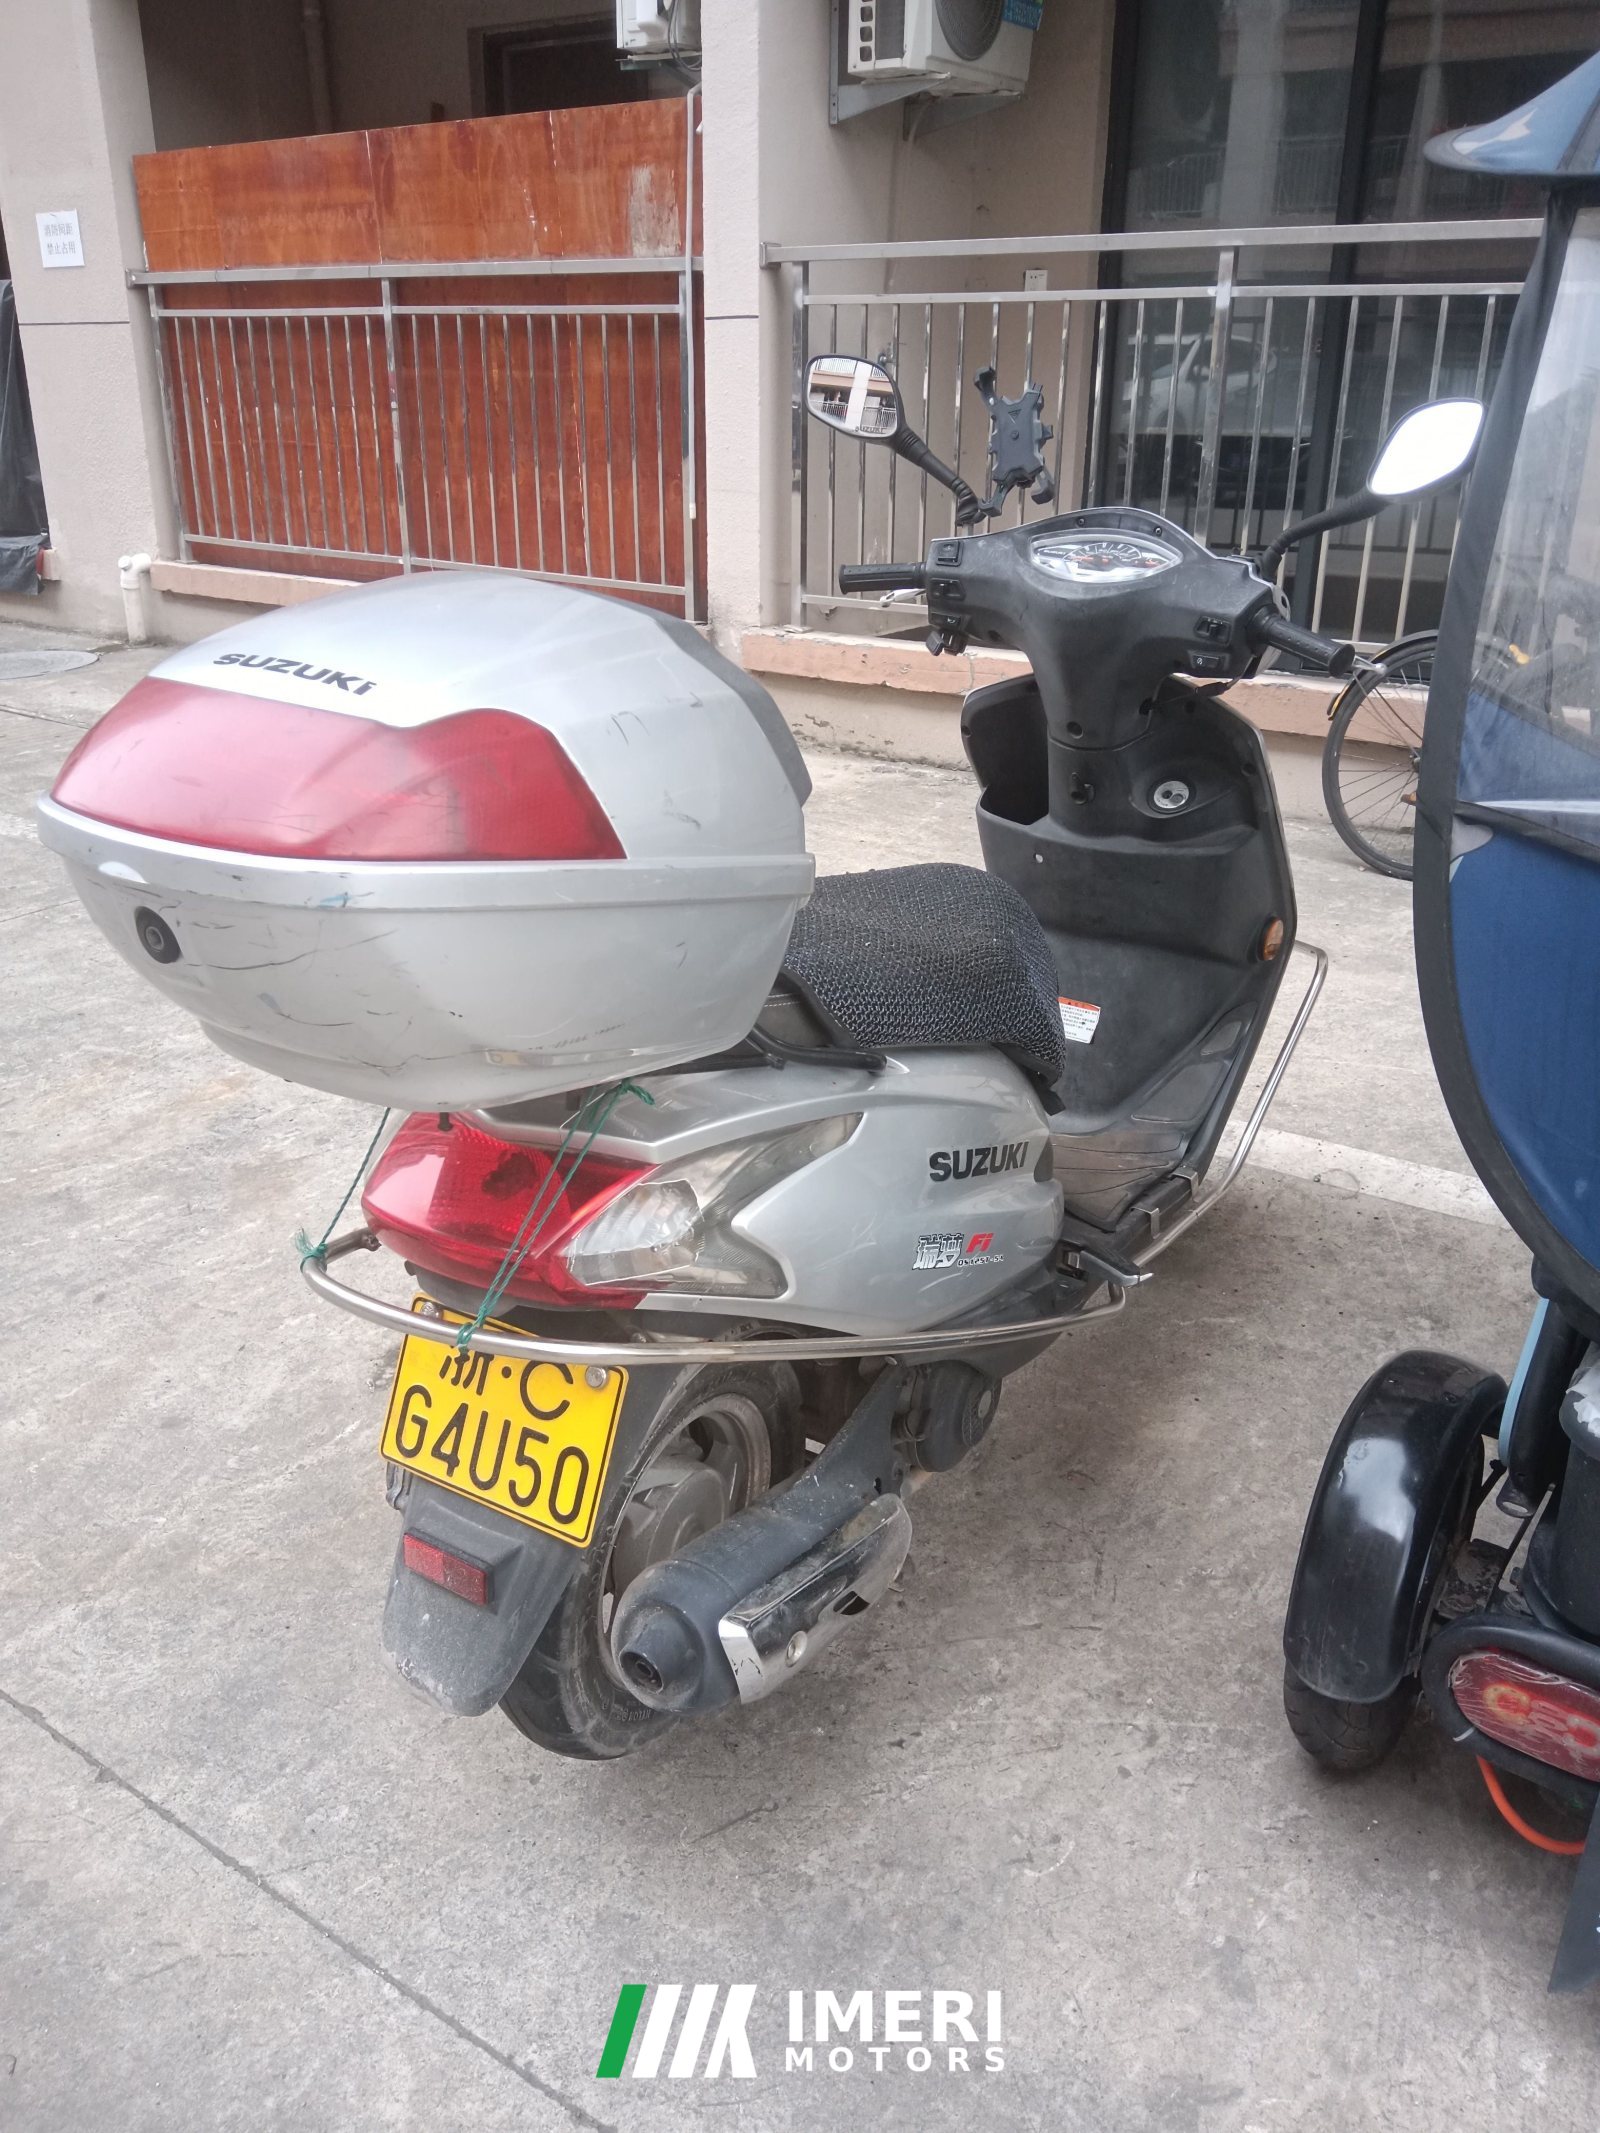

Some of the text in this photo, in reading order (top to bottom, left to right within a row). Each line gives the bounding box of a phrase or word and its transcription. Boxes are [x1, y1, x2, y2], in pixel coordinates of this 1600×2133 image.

[213, 653, 377, 696] SUZUKI
[929, 1141, 1030, 1182] SUZUKI
[912, 1233, 964, 1270] 瑞梦
[395, 1384, 589, 1524] G4U50
